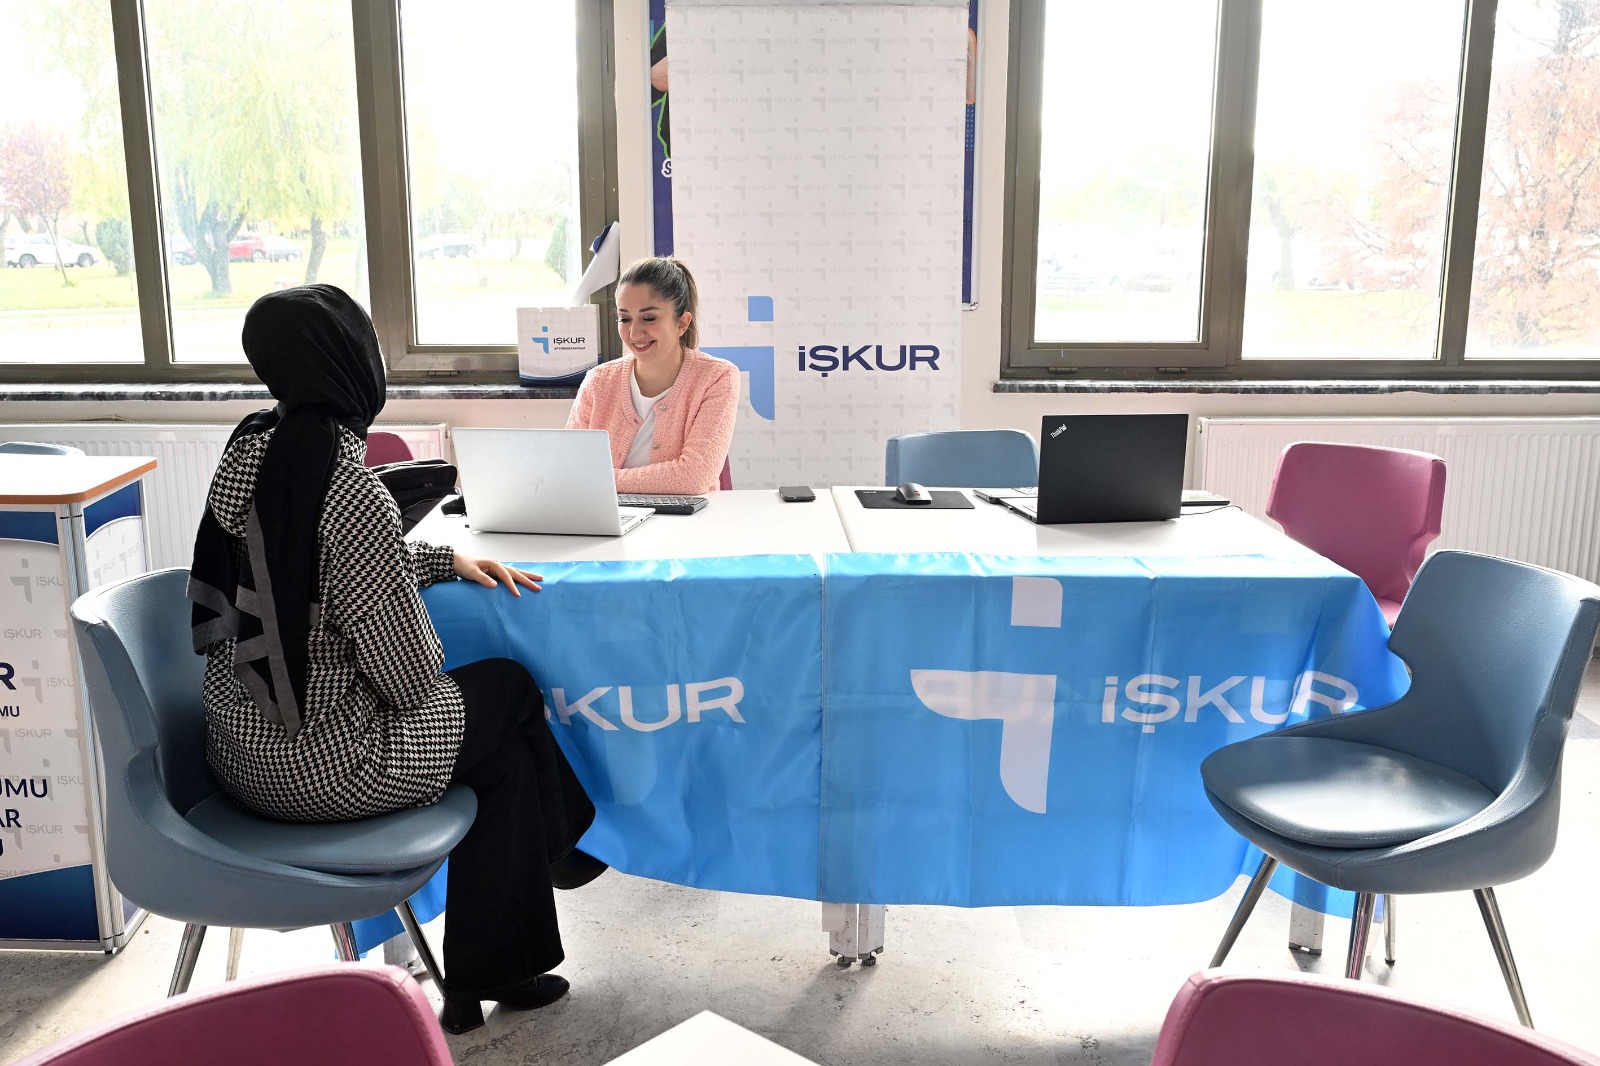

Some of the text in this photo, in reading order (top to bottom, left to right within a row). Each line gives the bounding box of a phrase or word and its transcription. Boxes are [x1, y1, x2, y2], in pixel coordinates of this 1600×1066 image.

[798, 344, 940, 378] İŞKUR
[541, 676, 746, 733] KUR
[1101, 670, 1359, 734] İŞKUR
[0, 778, 48, 798] MU
